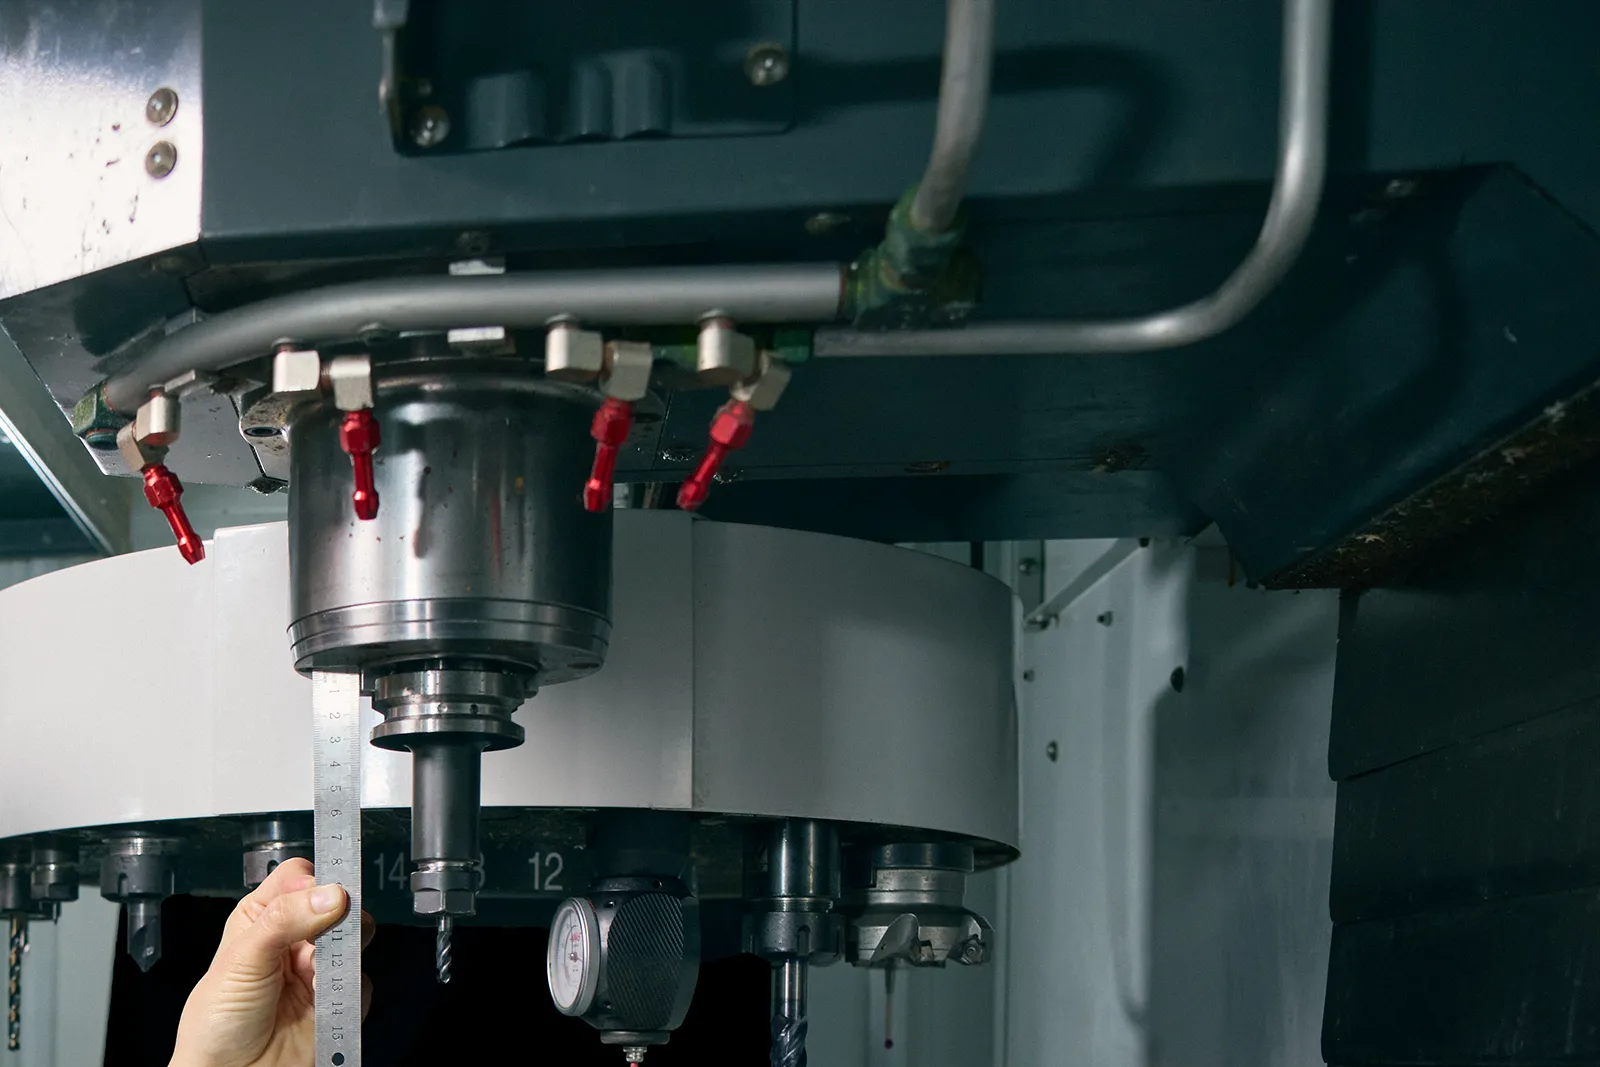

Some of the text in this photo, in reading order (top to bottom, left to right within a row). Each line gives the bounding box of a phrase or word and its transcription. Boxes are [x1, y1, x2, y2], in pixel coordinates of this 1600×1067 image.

[329, 712, 341, 720] 2
[329, 736, 341, 744] 3
[329, 760, 341, 768] 4
[329, 785, 342, 793] 5
[330, 809, 342, 817] 6
[331, 833, 343, 841] 7
[331, 858, 343, 866] 8
[373, 852, 408, 891] 14
[527, 851, 564, 891] 12
[331, 929, 343, 942] 11
[331, 953, 344, 967] 12
[331, 978, 344, 992] 13
[331, 1002, 343, 1016] 14
[331, 1026, 344, 1041] 15
